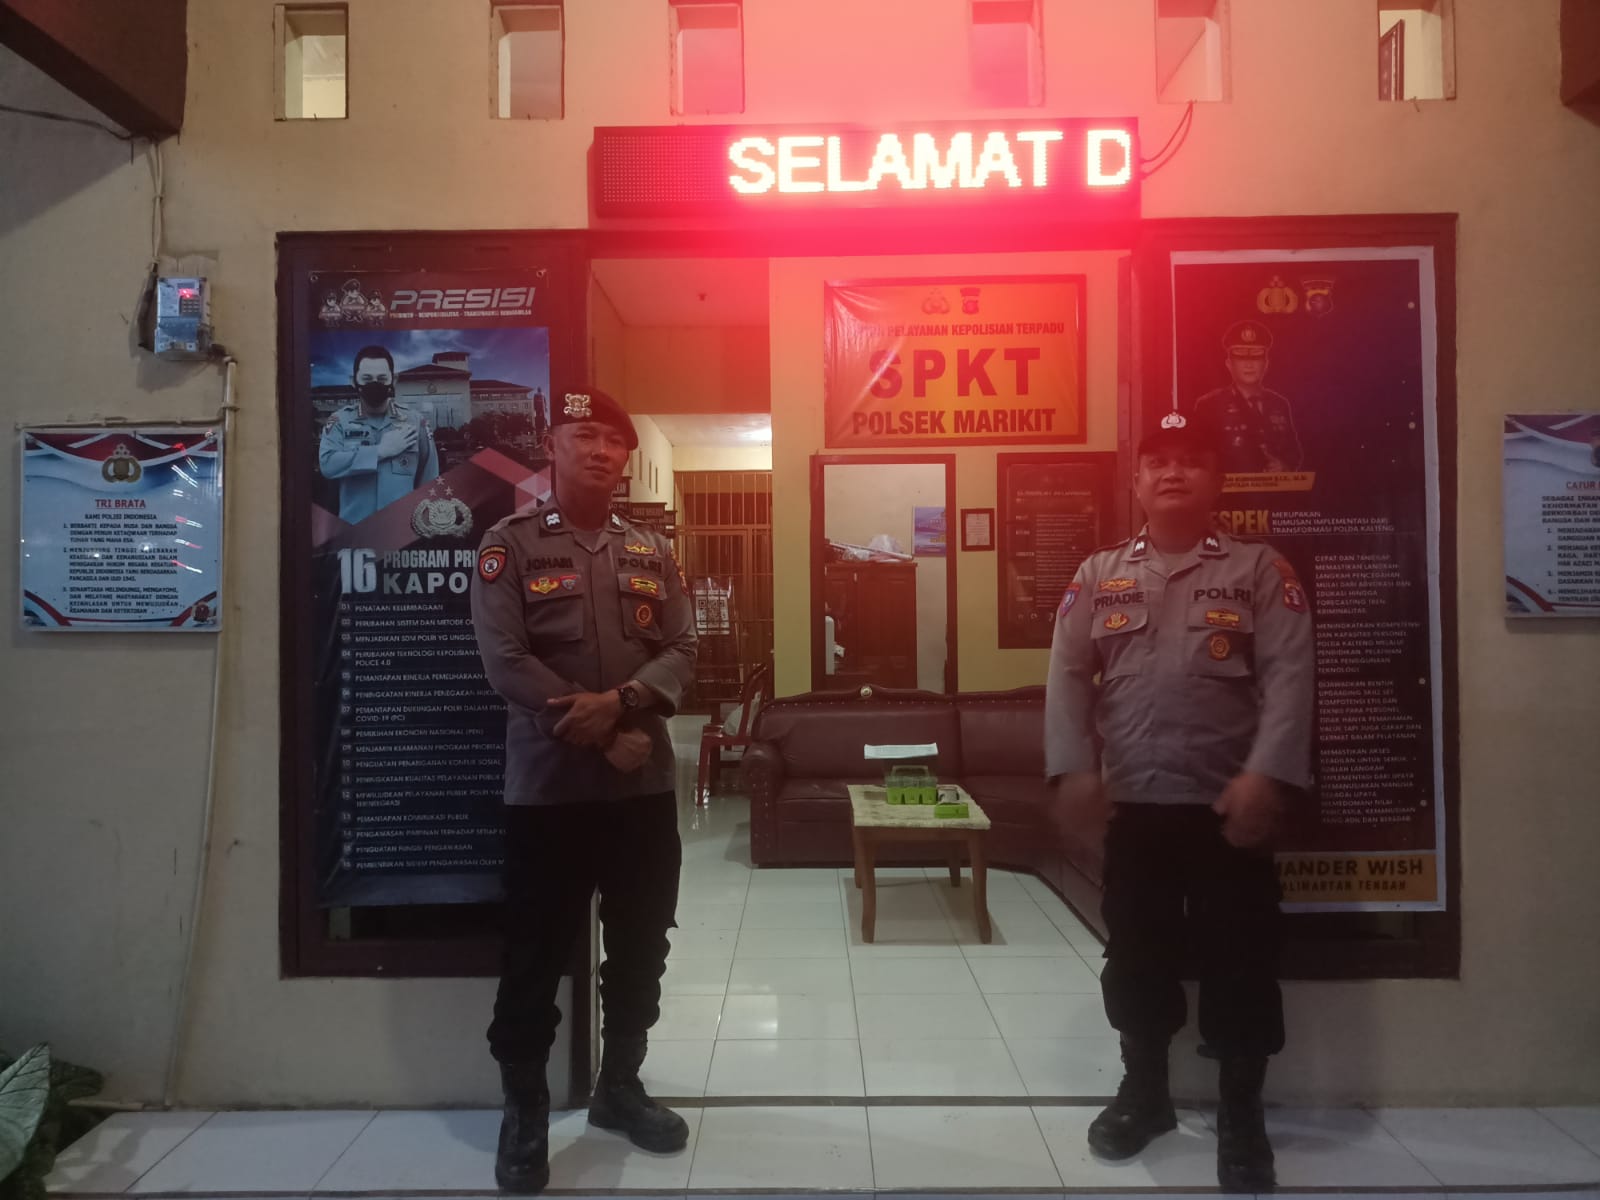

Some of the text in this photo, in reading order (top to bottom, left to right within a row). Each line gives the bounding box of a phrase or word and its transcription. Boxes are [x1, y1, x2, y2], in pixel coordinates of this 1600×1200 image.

[728, 130, 1131, 194] SELAMAT D
[390, 287, 536, 310] PRESISI
[888, 326, 948, 337] PELAYANAN
[952, 324, 1013, 335] KEPOLISIAN
[1016, 323, 1064, 334] TERPADU
[869, 348, 1041, 399] SPKT
[853, 409, 1056, 435] POLSEK MARIKIT
[1566, 481, 1595, 489] CATUR
[95, 499, 146, 508] TRI BRATA
[337, 548, 377, 594] 16
[384, 550, 449, 568] PROGRAM
[525, 557, 574, 572] JOHARI
[618, 558, 662, 574] POLRI
[384, 572, 468, 594] KAPO
[1093, 591, 1144, 610] PRIADIE
[1194, 588, 1251, 602] POLRI
[1368, 859, 1423, 875] WISH
[1359, 880, 1406, 890] TENGAH
